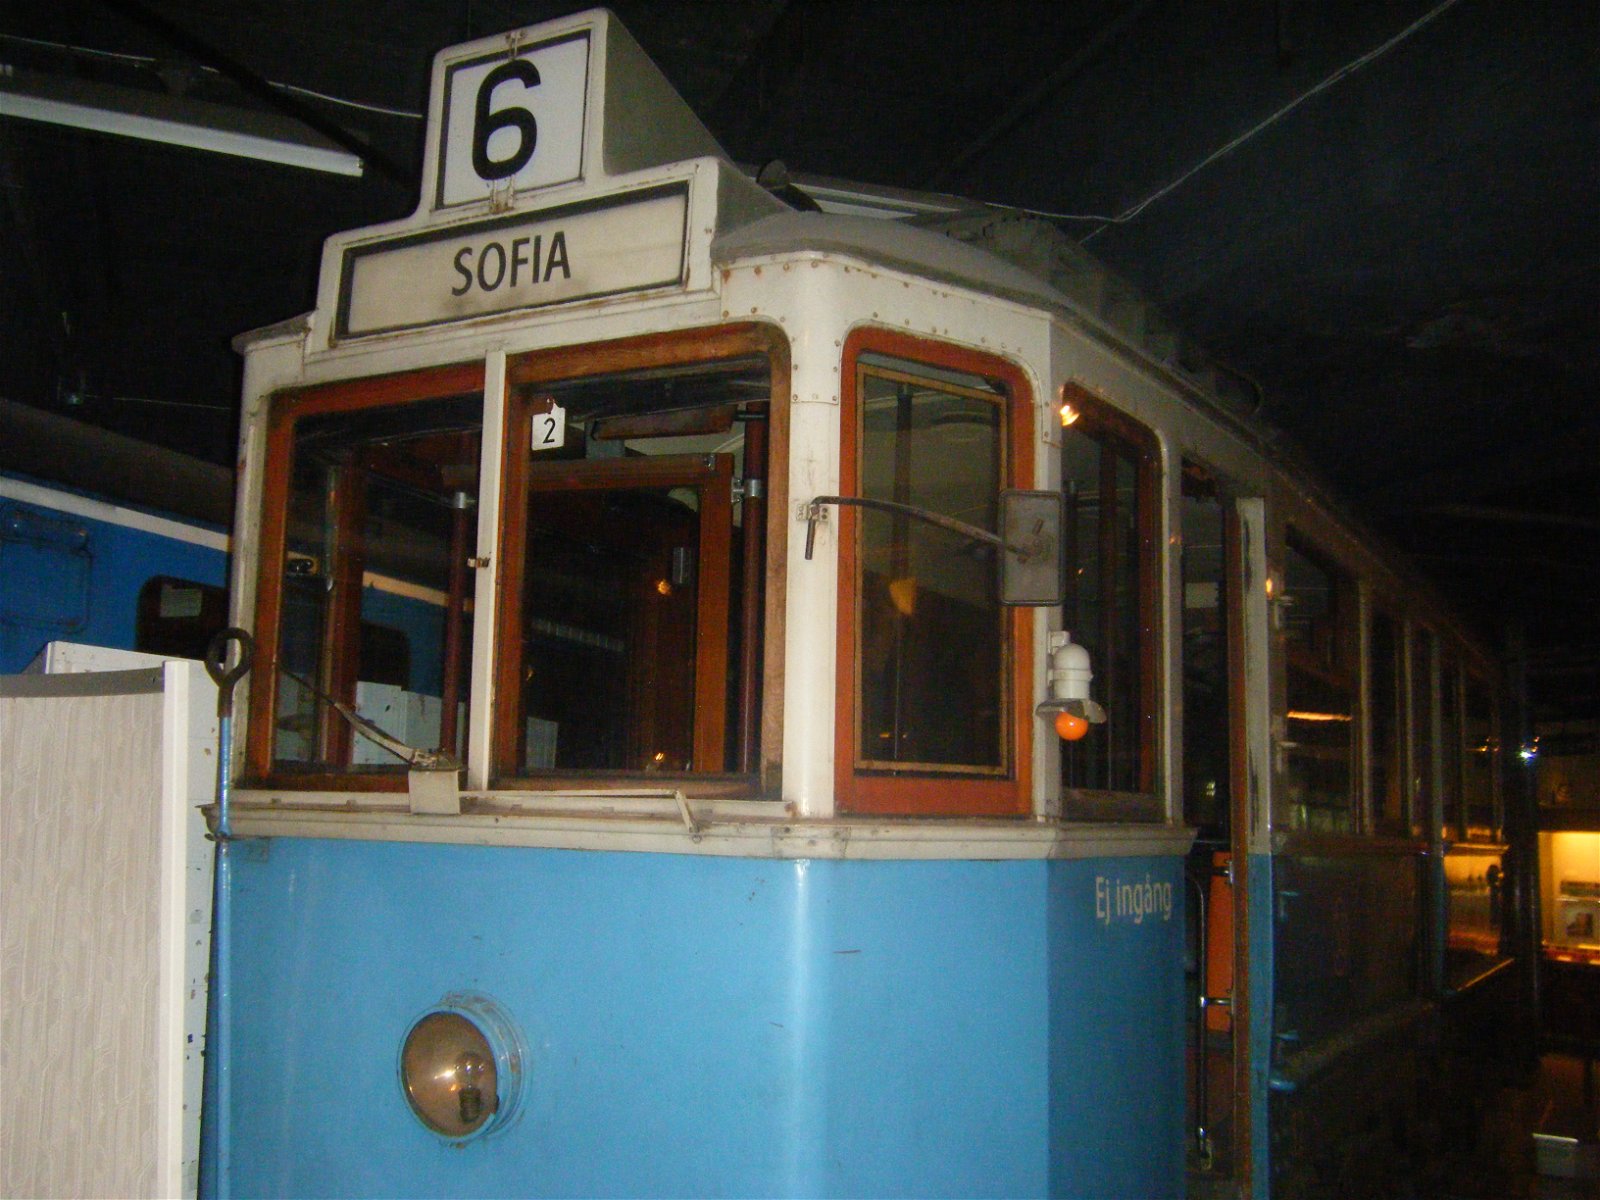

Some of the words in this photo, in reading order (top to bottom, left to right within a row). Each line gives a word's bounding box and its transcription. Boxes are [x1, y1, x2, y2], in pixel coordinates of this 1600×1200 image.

[471, 58, 541, 181] 6
[451, 230, 571, 297] SOFIA
[542, 417, 556, 444] 2
[1095, 876, 1110, 925] Ej
[1116, 872, 1172, 925] ingång
